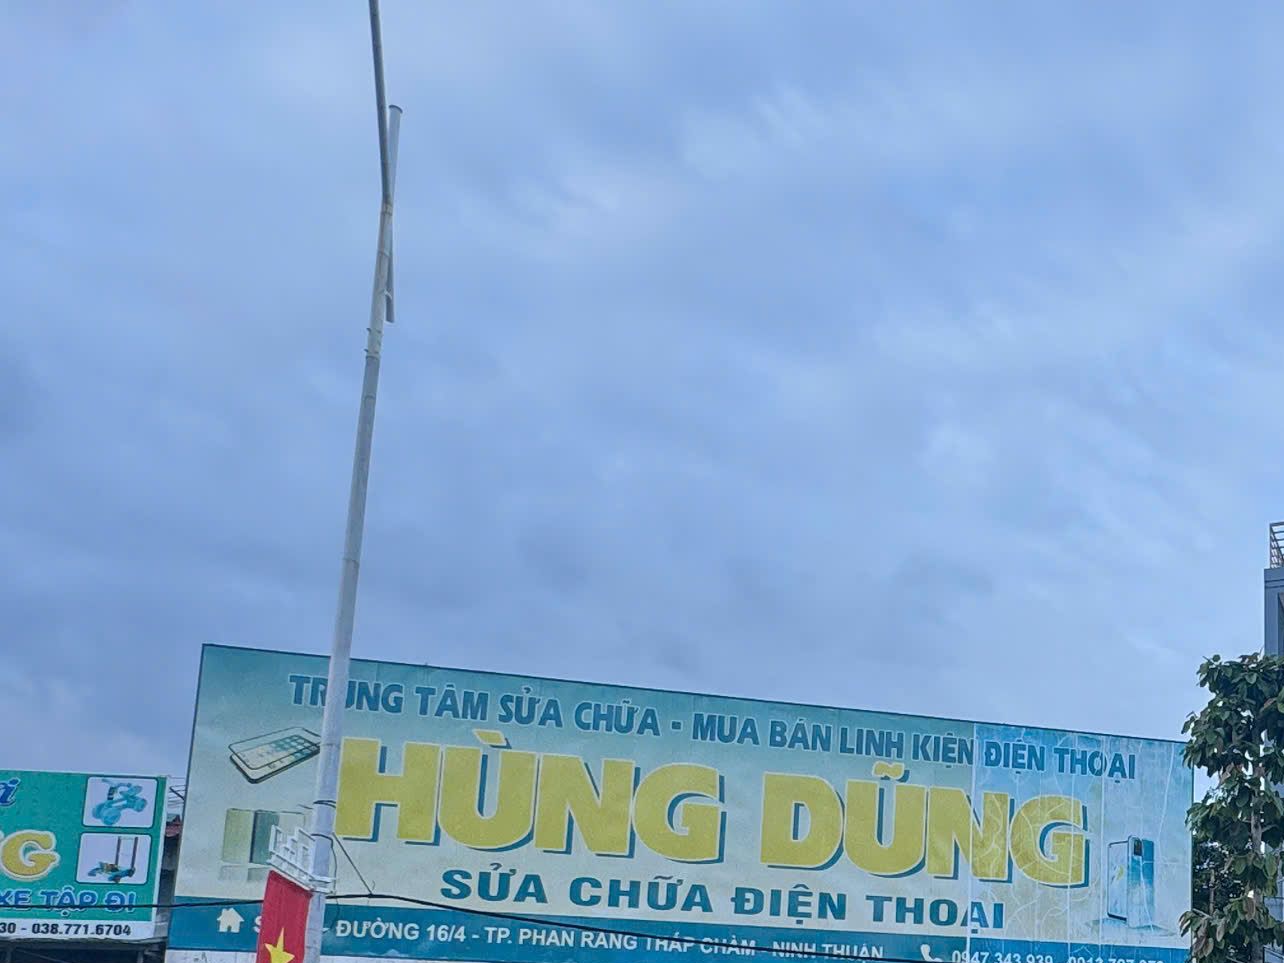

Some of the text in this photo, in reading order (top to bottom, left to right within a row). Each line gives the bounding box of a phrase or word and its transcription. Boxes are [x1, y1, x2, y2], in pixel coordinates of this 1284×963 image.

[415, 683, 490, 722] TÂM
[498, 686, 563, 729] SỬA
[574, 698, 661, 737] CHỮA
[692, 712, 760, 746] MUA
[769, 718, 832, 753] BÁN
[839, 726, 904, 760] LINH
[1053, 746, 1137, 785] THOẠI
[334, 729, 1091, 889] HÙNG DŨNG
[32, 922, 131, 936] 038.771.6704
[440, 861, 1006, 936] SỬA CHỮA ĐIỆN THOẠI
[335, 917, 420, 941] ĐƯỜNG
[426, 924, 466, 943] 16/4
[518, 928, 575, 949] PHAN
[580, 930, 638, 951] RANG
[645, 931, 694, 953] THÁP
[773, 940, 816, 960] NINH
